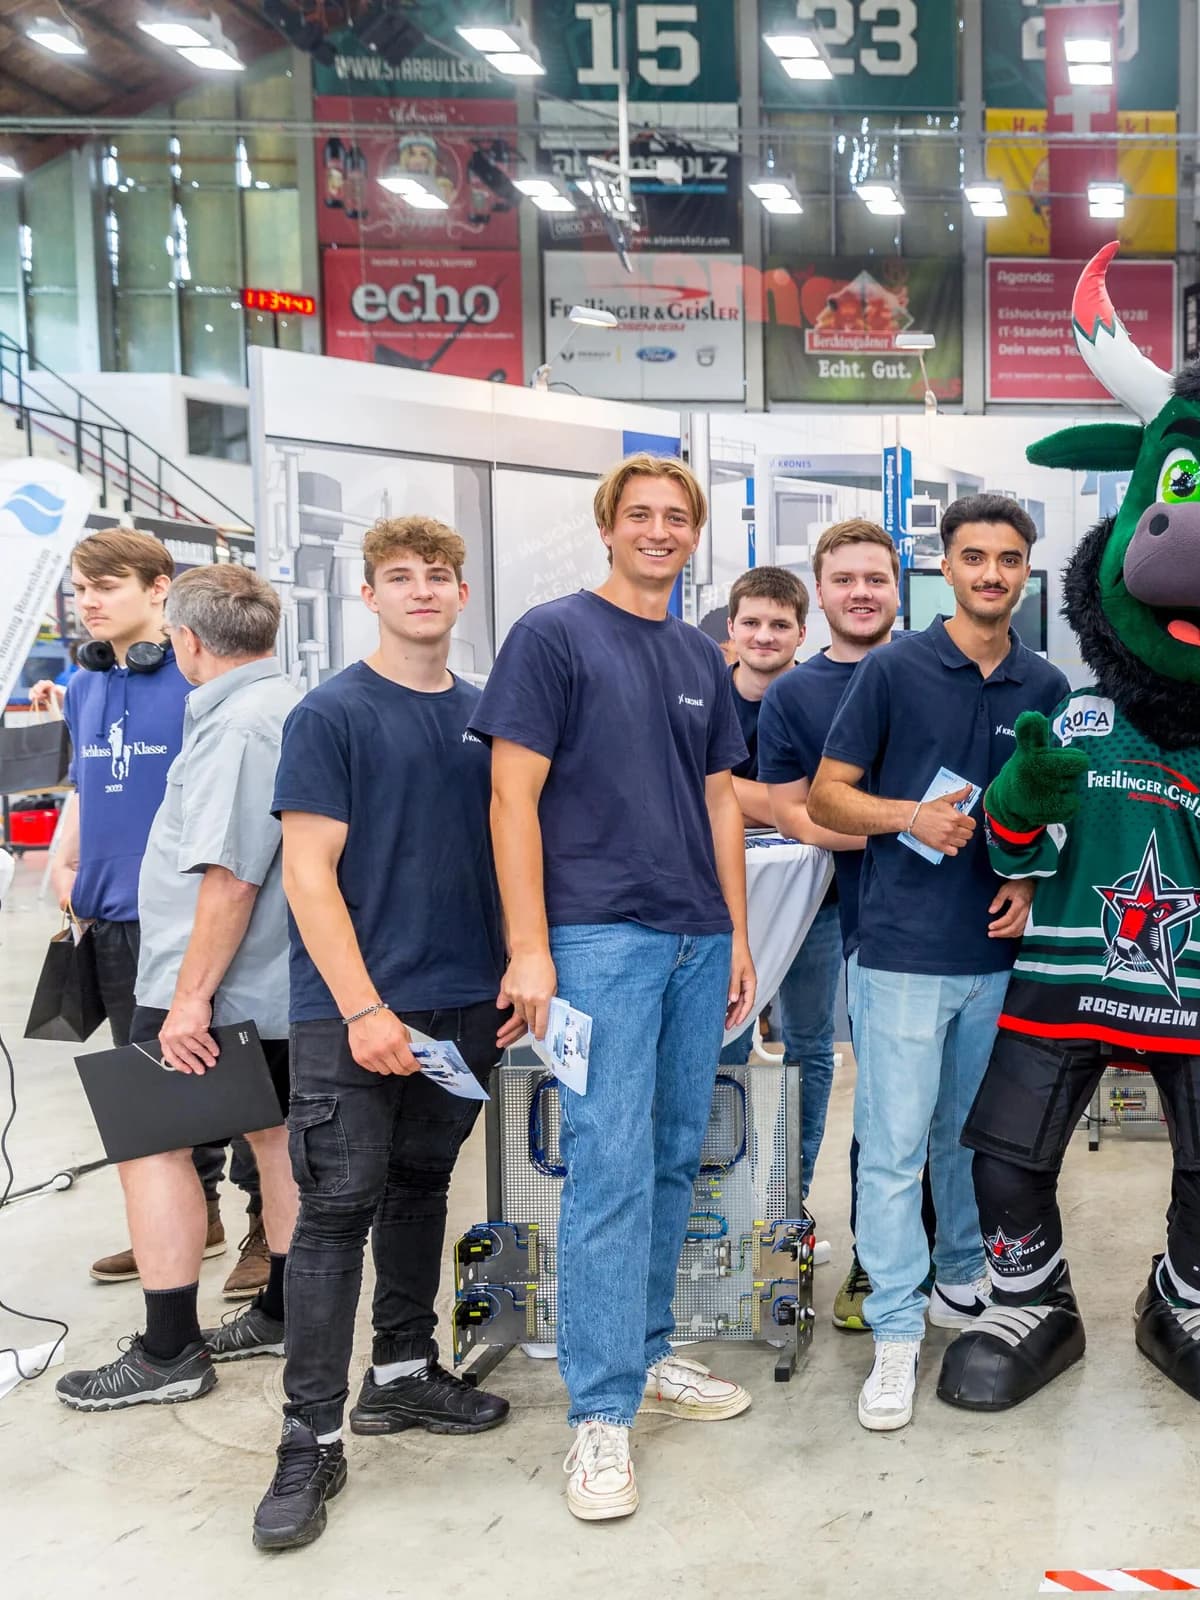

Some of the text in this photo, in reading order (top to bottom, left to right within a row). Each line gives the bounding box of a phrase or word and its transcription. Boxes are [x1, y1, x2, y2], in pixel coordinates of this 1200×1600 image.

[575, 3, 700, 86] 15
[352, 274, 499, 323] echo
[818, 359, 912, 380] Echt. Gut.
[778, 460, 812, 468] KRONES
[1002, 727, 1017, 737] KRO
[133, 741, 168, 755] Klasse
[1078, 995, 1198, 1027] ROSENHEIM
